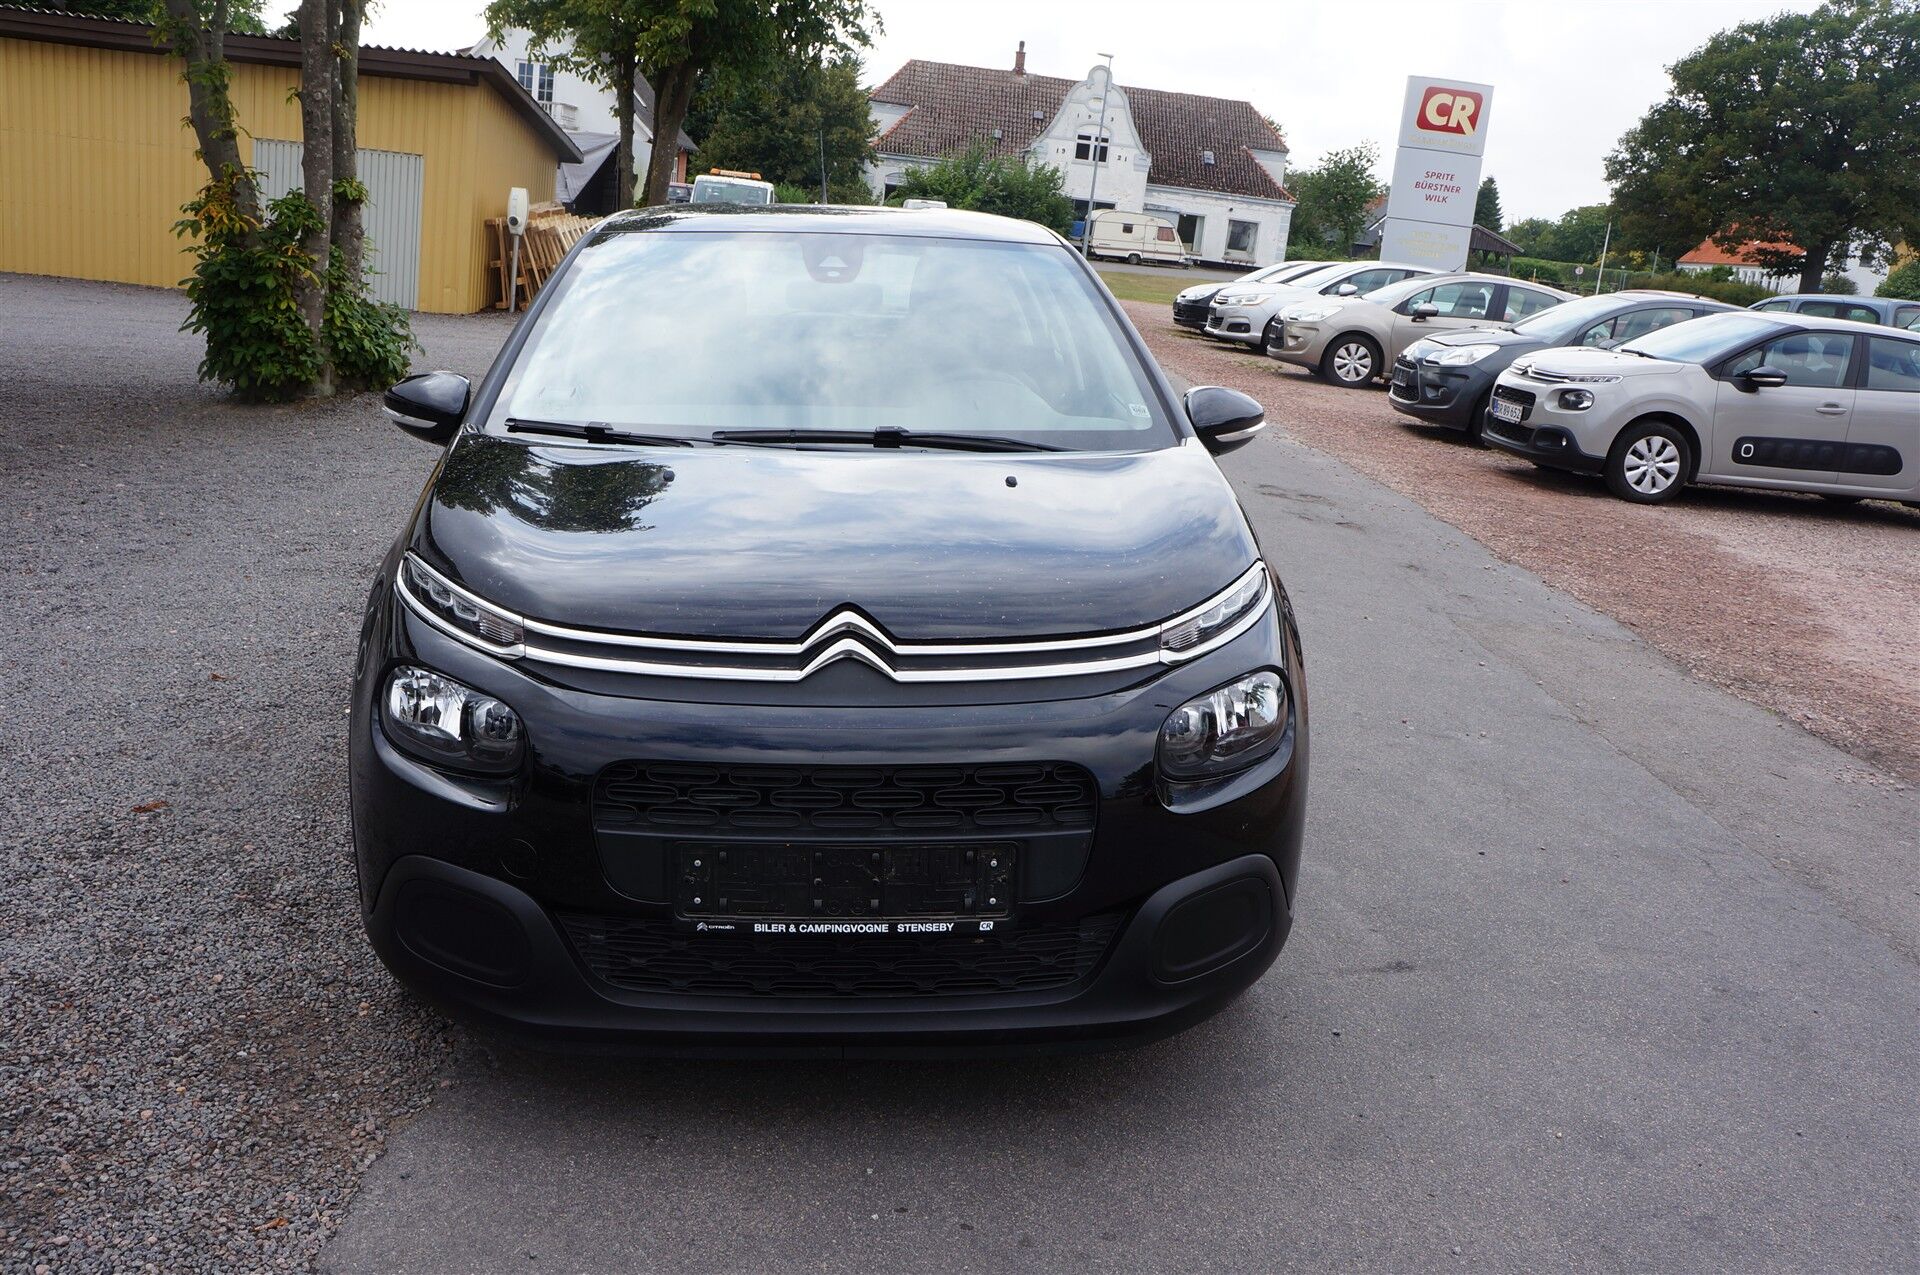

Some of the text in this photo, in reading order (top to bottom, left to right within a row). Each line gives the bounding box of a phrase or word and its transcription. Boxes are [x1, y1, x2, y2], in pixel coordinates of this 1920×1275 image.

[1425, 92, 1476, 136] CR
[1424, 170, 1456, 182] SPRITE
[1414, 180, 1462, 194] BÜRSTNER
[1425, 193, 1449, 204] WILK
[754, 923, 955, 933] BILER & CAMPINGVOGNE STENSEBY
[980, 921, 994, 931] CR
